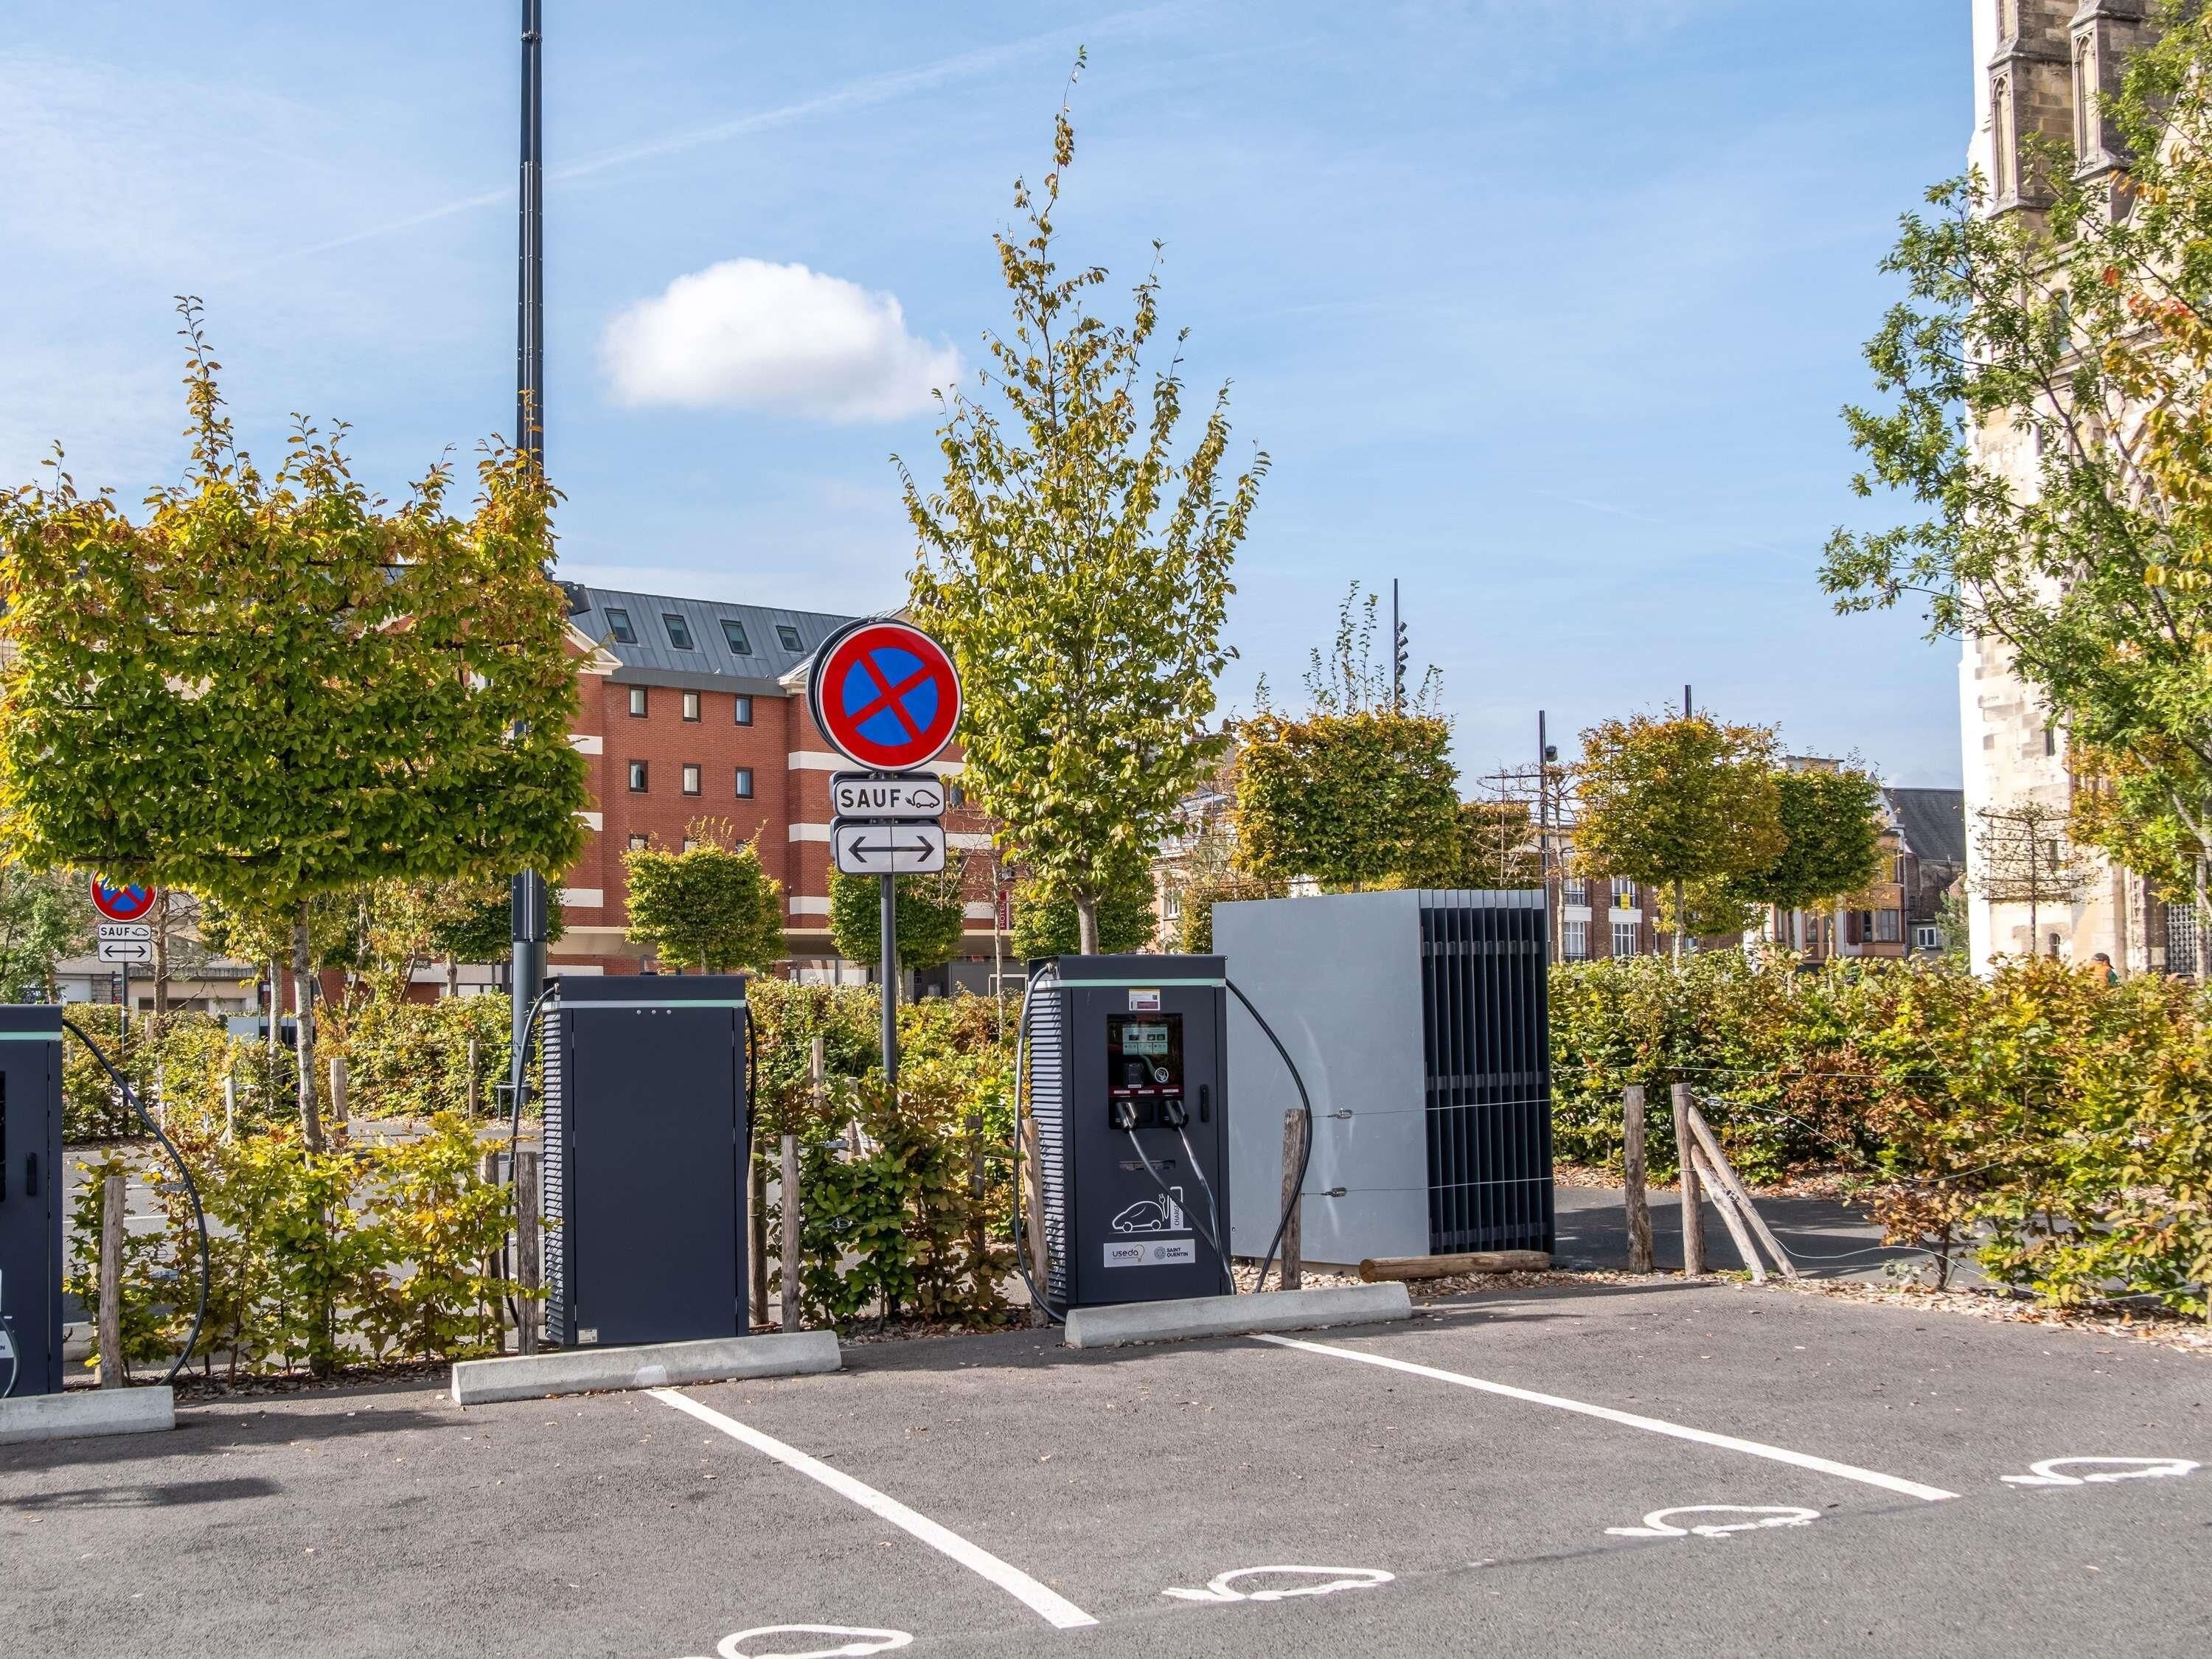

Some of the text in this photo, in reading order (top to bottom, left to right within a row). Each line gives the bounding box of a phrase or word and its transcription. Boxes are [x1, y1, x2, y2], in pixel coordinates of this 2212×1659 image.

[841, 788, 901, 808] SAUF
[100, 927, 131, 936] SAUF
[1112, 1248, 1138, 1256] useda
